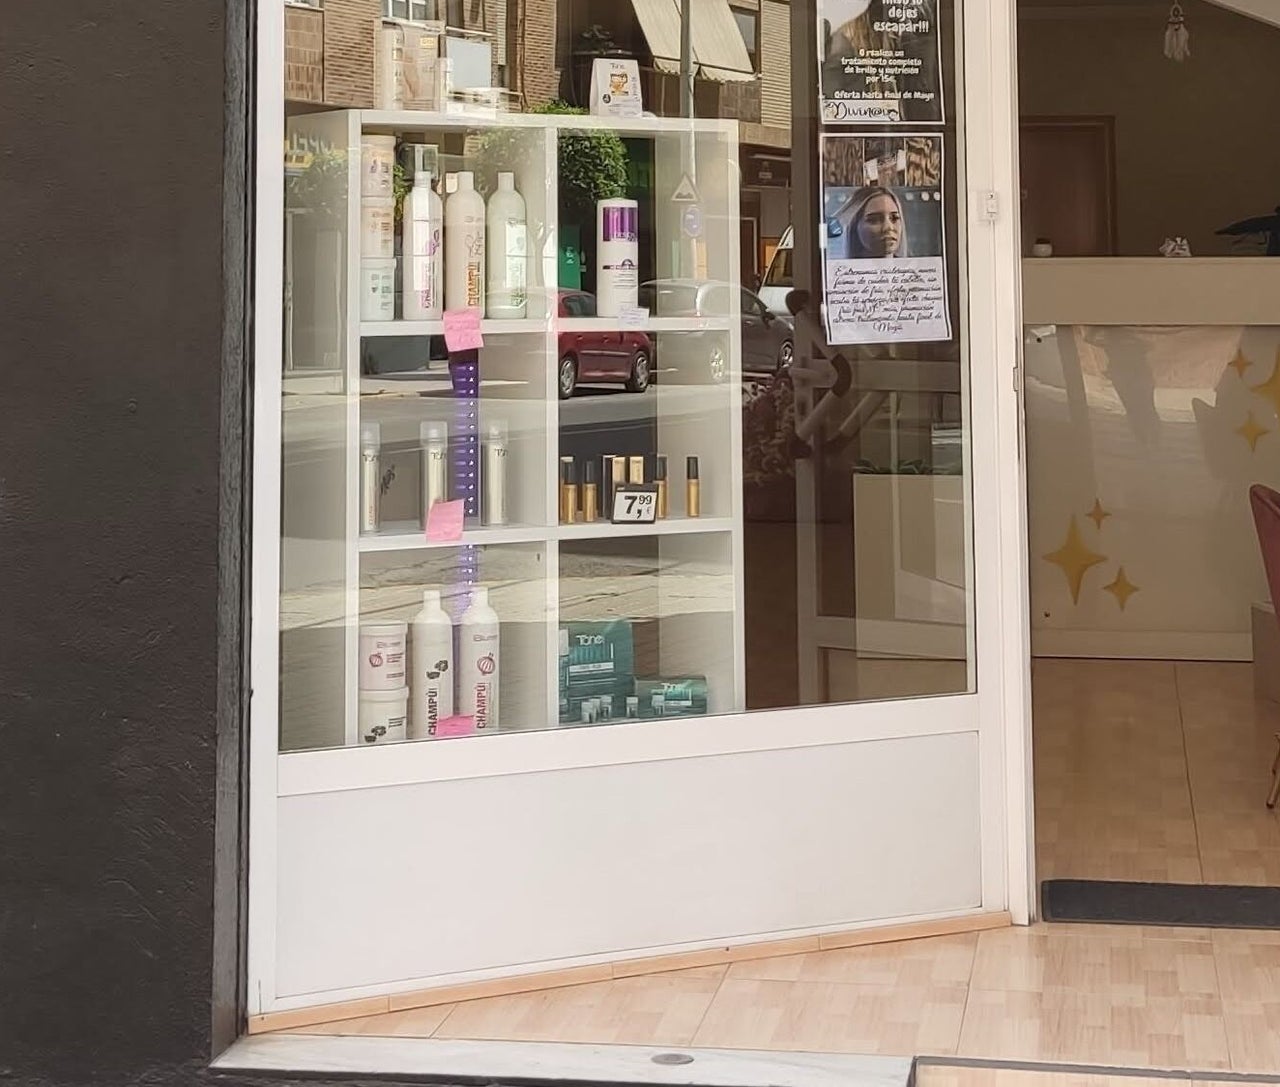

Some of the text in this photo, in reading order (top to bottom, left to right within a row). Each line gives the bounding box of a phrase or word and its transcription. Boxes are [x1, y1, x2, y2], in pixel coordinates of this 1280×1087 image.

[873, 20, 929, 36] escapar!!!
[841, 57, 922, 67] tratamiento completo
[844, 66, 854, 74] de
[856, 66, 877, 74] brillo
[878, 67, 884, 76] y
[866, 75, 880, 84] por
[834, 91, 860, 99] Oferta
[862, 91, 883, 99] hasta
[903, 91, 912, 99] de
[914, 92, 935, 102] Mayo
